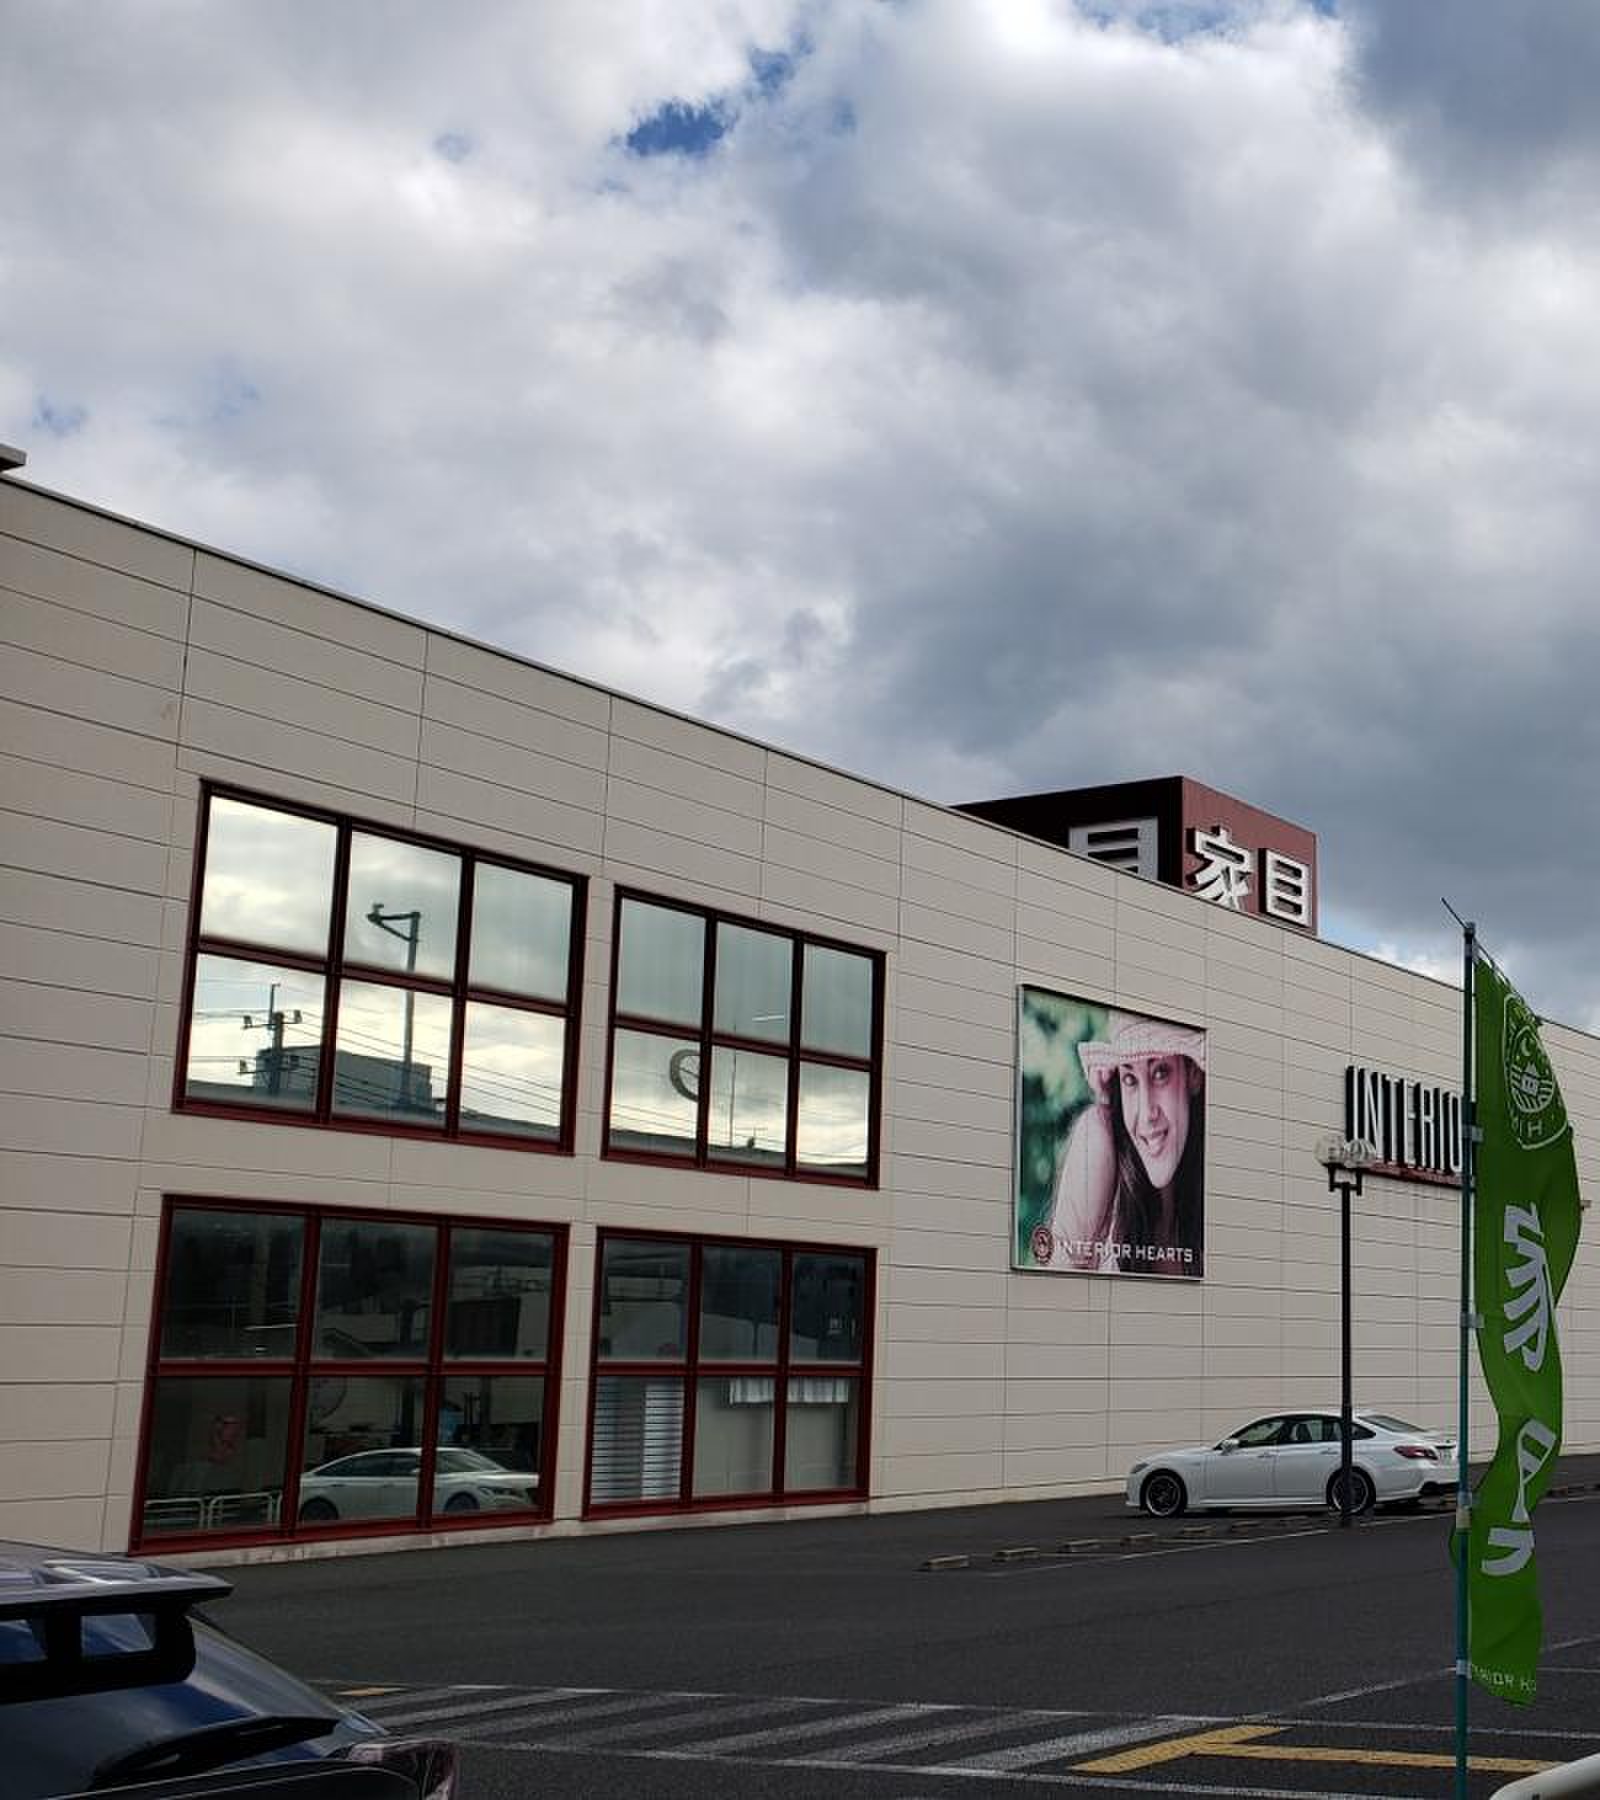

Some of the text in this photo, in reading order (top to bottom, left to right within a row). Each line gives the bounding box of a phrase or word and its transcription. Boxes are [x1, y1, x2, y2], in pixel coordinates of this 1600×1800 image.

[1345, 1065, 1463, 1172] INTERIO
[1056, 1240, 1131, 1260] INTERIOR
[1135, 1245, 1193, 1264] HEARTS
